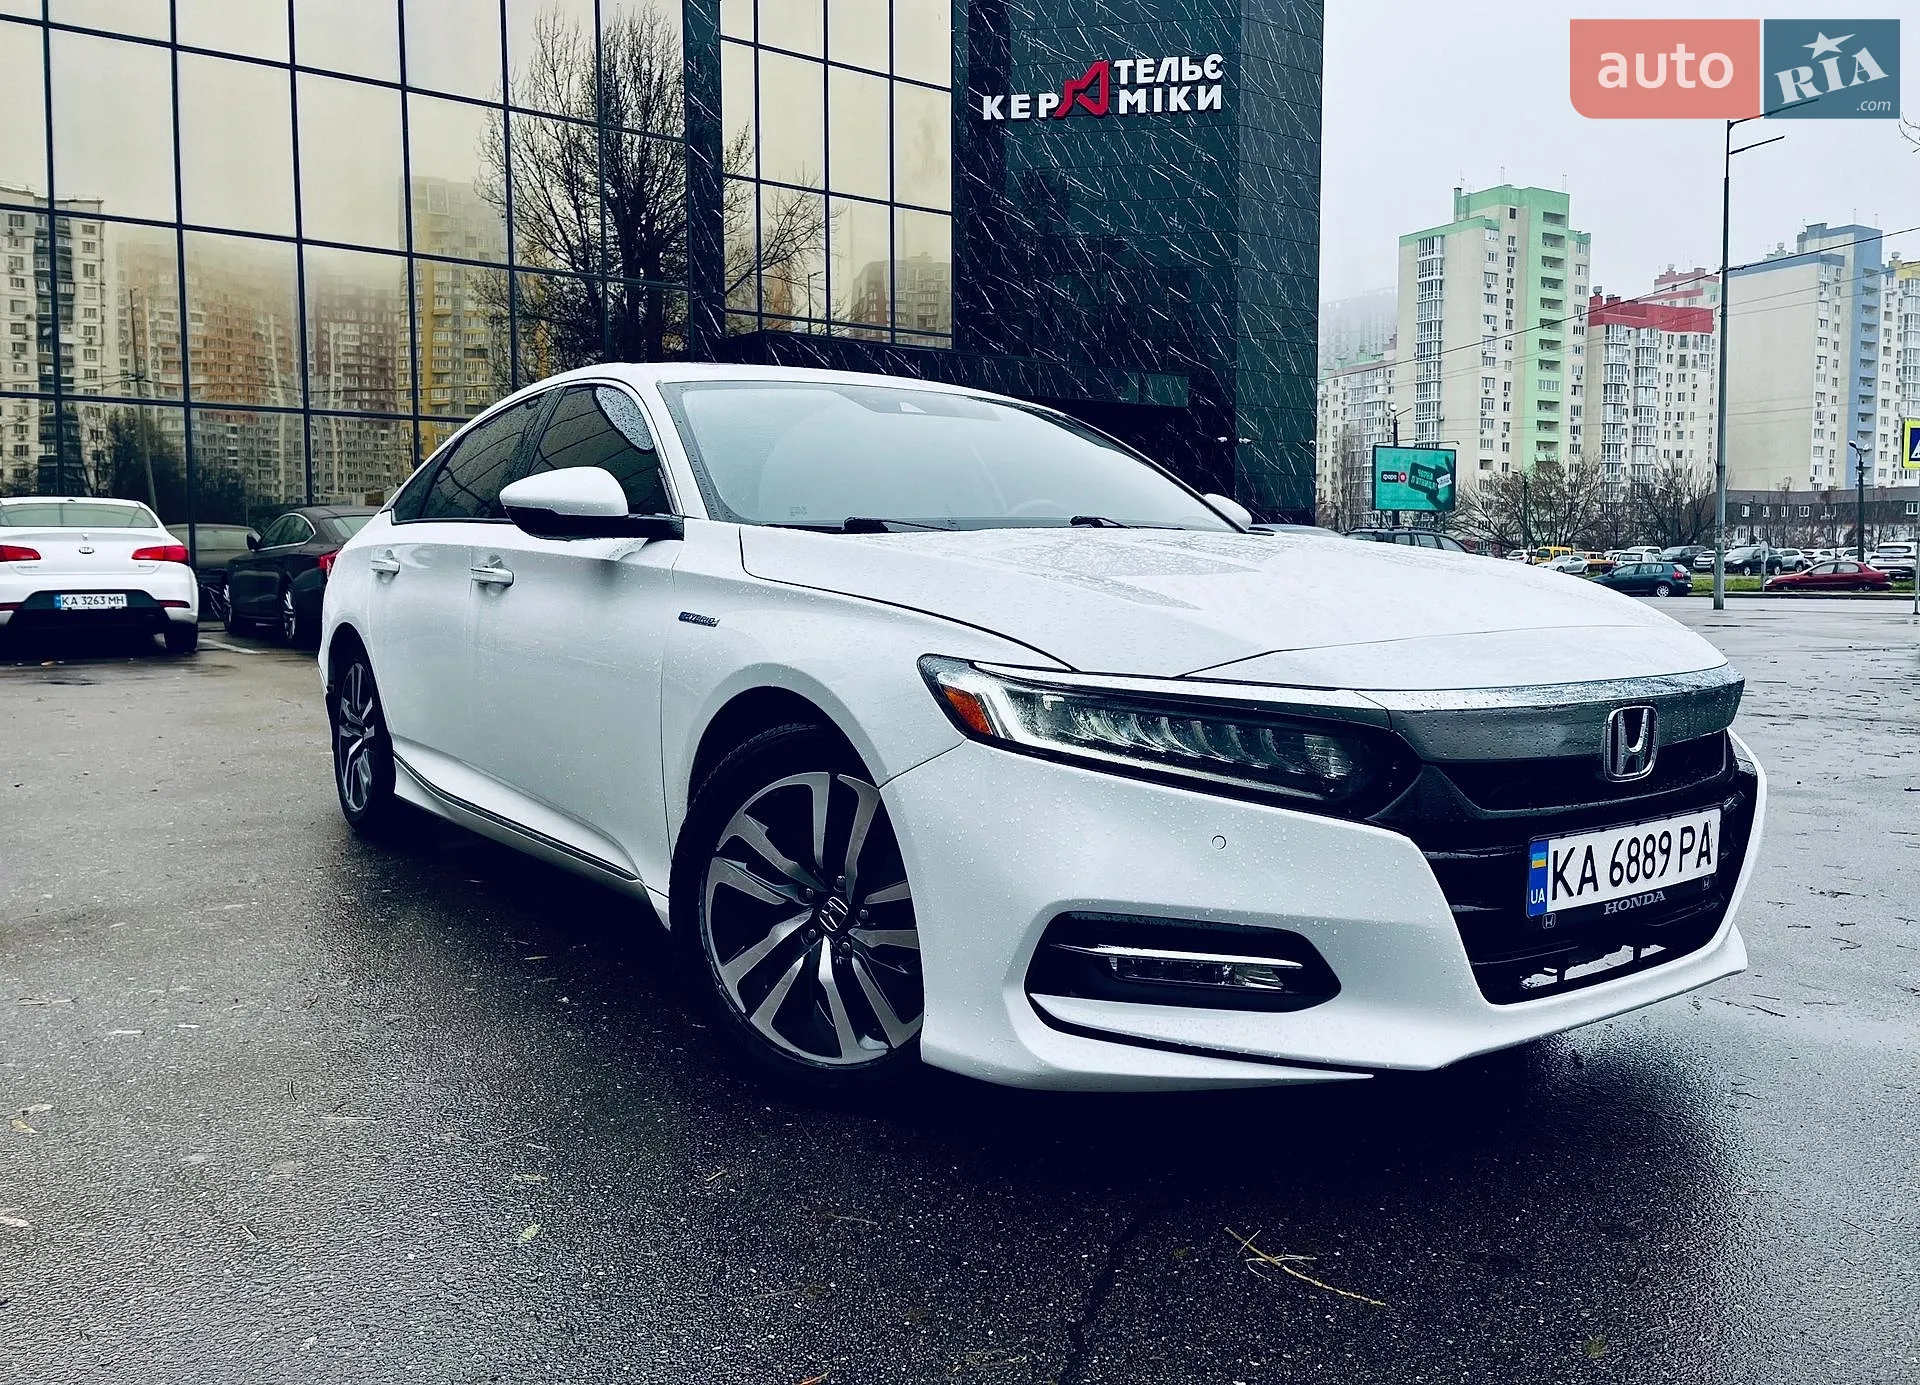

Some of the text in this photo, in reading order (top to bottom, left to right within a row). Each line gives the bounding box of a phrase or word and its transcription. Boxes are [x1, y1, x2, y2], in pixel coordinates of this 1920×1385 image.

[62, 595, 125, 605] KA 3263 MH
[1551, 818, 1713, 901] KA 6889 PA
[1530, 887, 1546, 905] UA
[1603, 890, 1667, 916] HONDA
